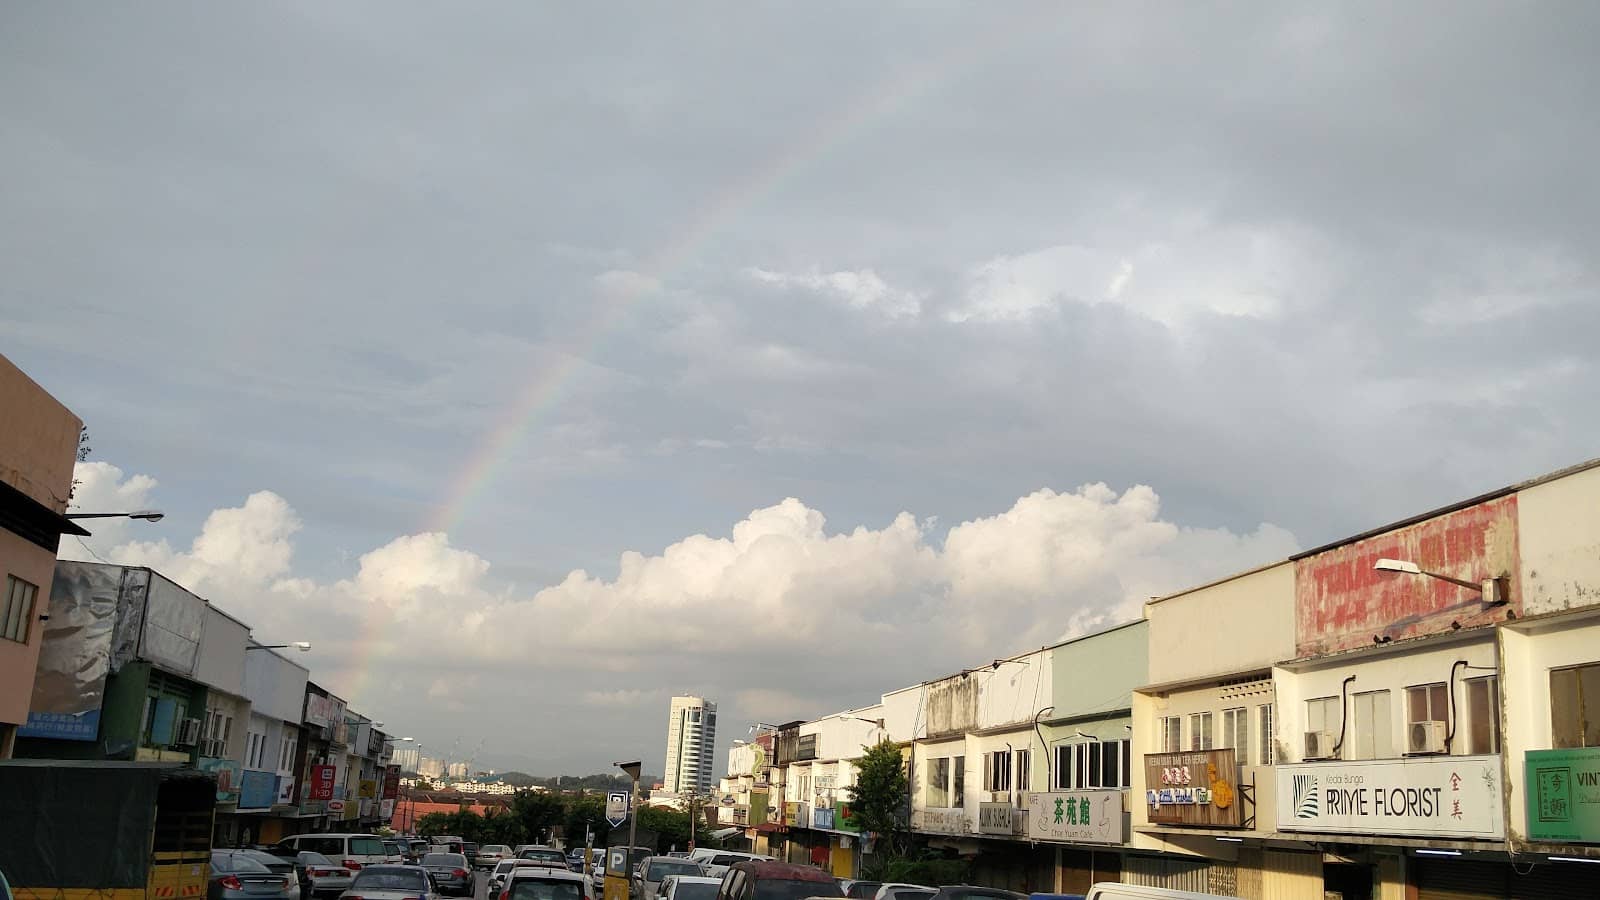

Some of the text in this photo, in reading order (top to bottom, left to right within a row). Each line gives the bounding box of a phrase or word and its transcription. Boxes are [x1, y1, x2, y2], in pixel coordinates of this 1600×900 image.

[1325, 774, 1364, 786] Kedai Bunga
[1577, 771, 1600, 787] VIN
[1326, 787, 1442, 817] PRIME FLORIST
[1450, 772, 1463, 820] 全美
[1054, 796, 1090, 826] 茶苑館
[611, 852, 623, 869] P
